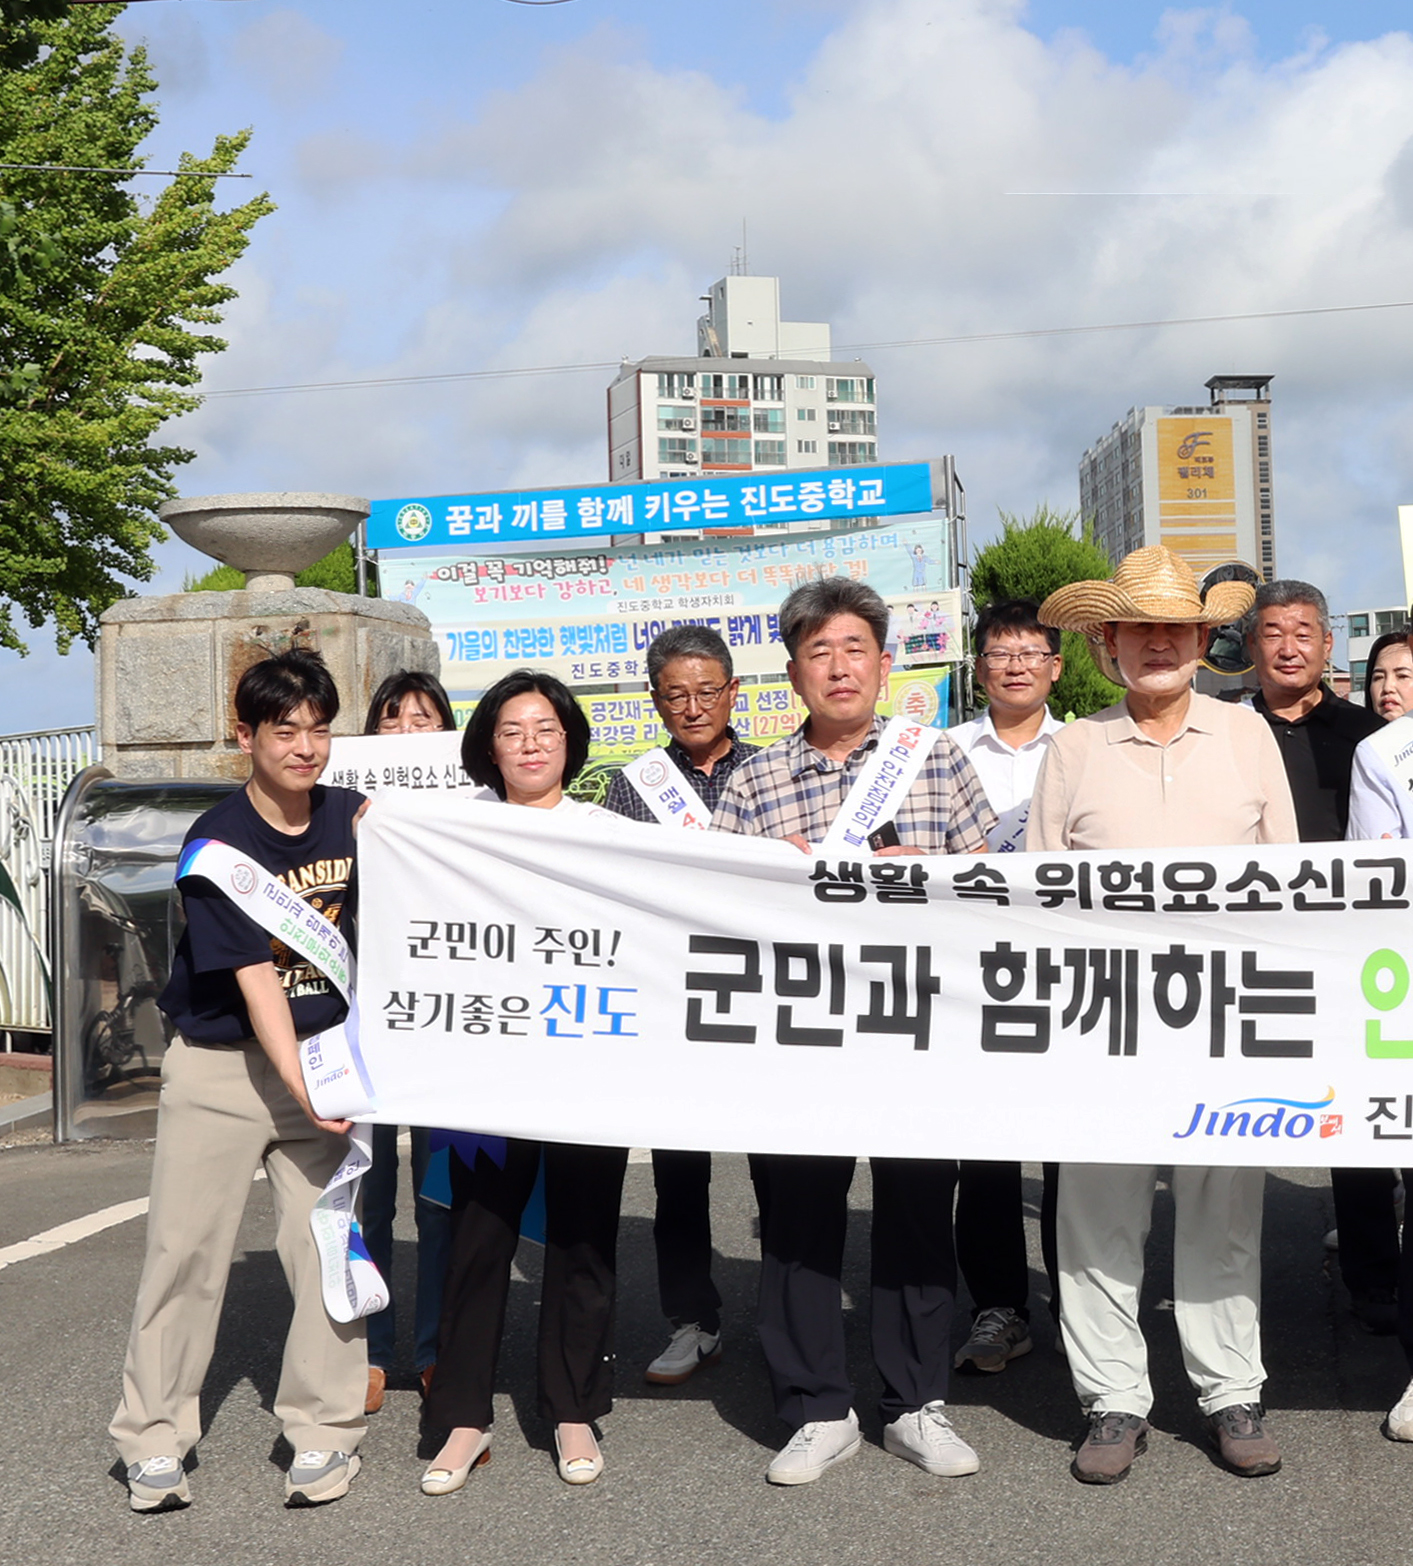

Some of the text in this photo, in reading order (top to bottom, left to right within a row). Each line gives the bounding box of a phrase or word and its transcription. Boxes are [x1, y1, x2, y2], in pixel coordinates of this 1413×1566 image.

[445, 503, 503, 535] 꿈과
[511, 499, 568, 532] 끼를
[577, 494, 634, 528] 함께
[645, 489, 730, 521] 키우는
[740, 478, 886, 517] 진도중학교
[1187, 488, 1207, 499] 301
[436, 561, 478, 586] 이걸
[485, 560, 504, 583] 꼭
[512, 555, 608, 579] 기억해줘!
[733, 542, 788, 562] 것보다
[795, 539, 816, 557] 더
[821, 532, 899, 558] 용감하며
[473, 582, 547, 604] 보기보다
[623, 578, 645, 594] 네
[650, 569, 730, 594] 생각보다
[736, 567, 758, 585] 더
[617, 594, 735, 613] 진도중학교 학생자치회
[446, 629, 498, 661] 가을의
[502, 627, 554, 659] 찬란한
[559, 622, 628, 655] 햇빛처럼
[727, 614, 761, 646] 밝게
[591, 699, 656, 722] 공간재구
[905, 692, 926, 716] 축
[365, 768, 377, 791] 속
[444, 763, 484, 789] 신고
[851, 760, 905, 830] 안전점검의
[659, 786, 687, 814] 매월
[808, 859, 929, 904] 생활
[953, 861, 1010, 906] 속
[406, 919, 621, 968] 군민이 주인!
[382, 983, 639, 1038] 살기좋은 진도
[685, 933, 941, 1050] 군민과
[980, 941, 1316, 1058] 함께하는
[314, 1071, 344, 1090] Jindo
[1172, 1101, 1314, 1140] Jindo
